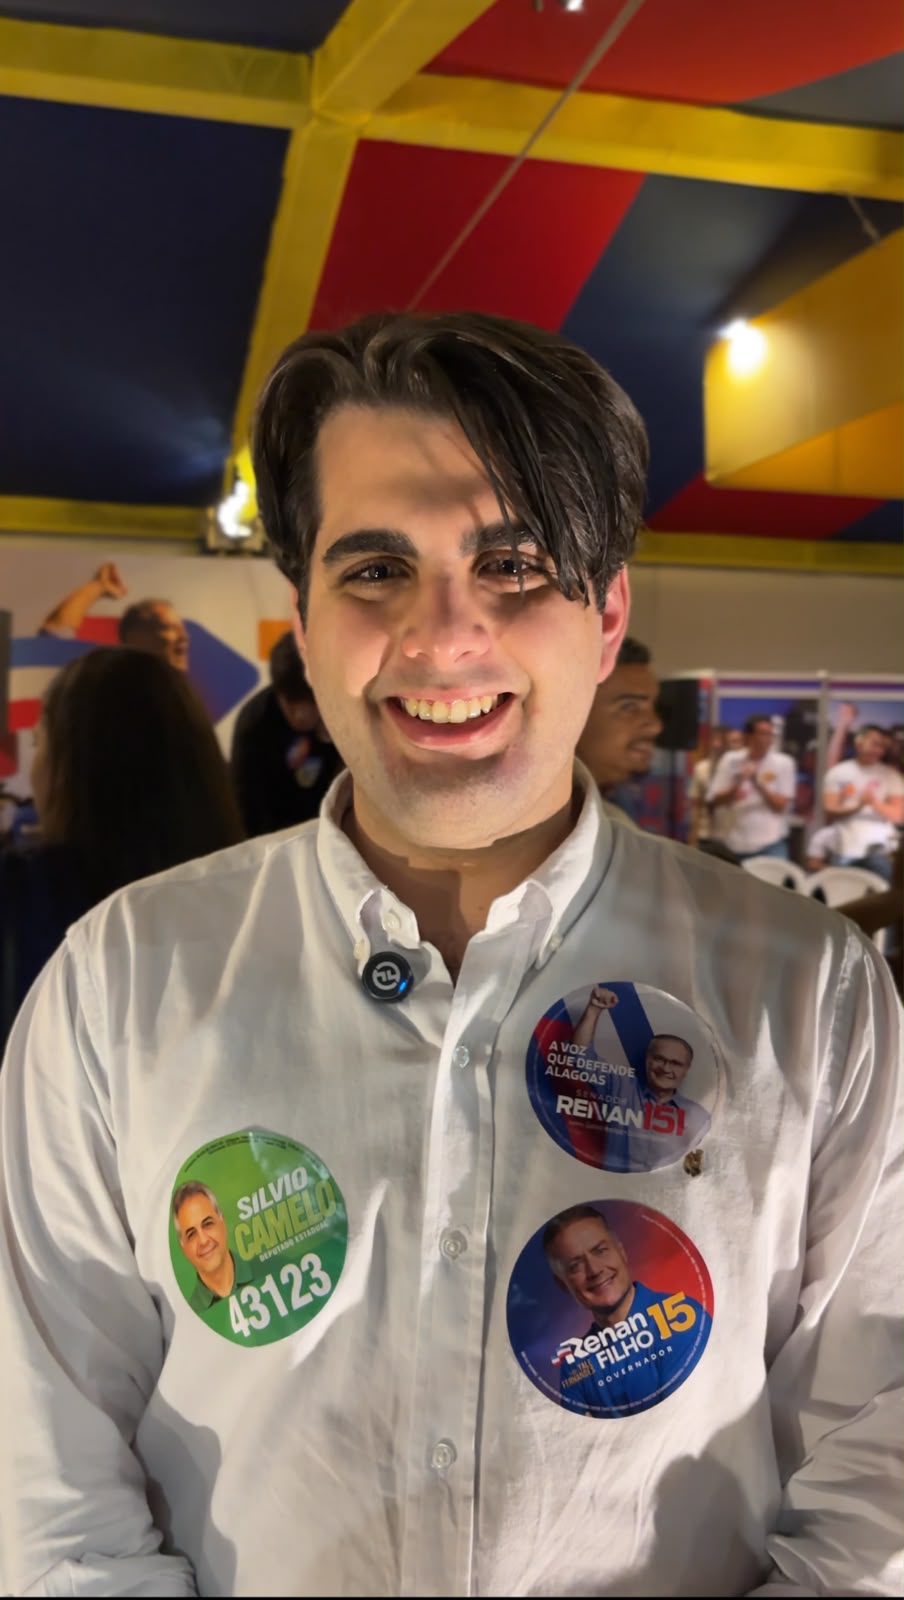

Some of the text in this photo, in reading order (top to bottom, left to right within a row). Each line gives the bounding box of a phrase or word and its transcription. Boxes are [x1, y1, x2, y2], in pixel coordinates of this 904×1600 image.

[547, 1052, 636, 1078] QUE DEFENDE
[549, 1041, 587, 1056] A VOZ
[545, 1065, 606, 1085] ALAGOAS
[556, 1094, 643, 1129] RENAN
[576, 1090, 628, 1104] SENADOR
[236, 1166, 309, 1221] SILVIO
[234, 1180, 336, 1262] CAMELO
[259, 1220, 329, 1262] DEPUTADO ESTADUAL
[228, 1252, 332, 1338] 43123
[552, 1291, 697, 1366] Renan 15
[596, 1329, 654, 1369] FILHO
[597, 1345, 674, 1388] GOVERNADOR
